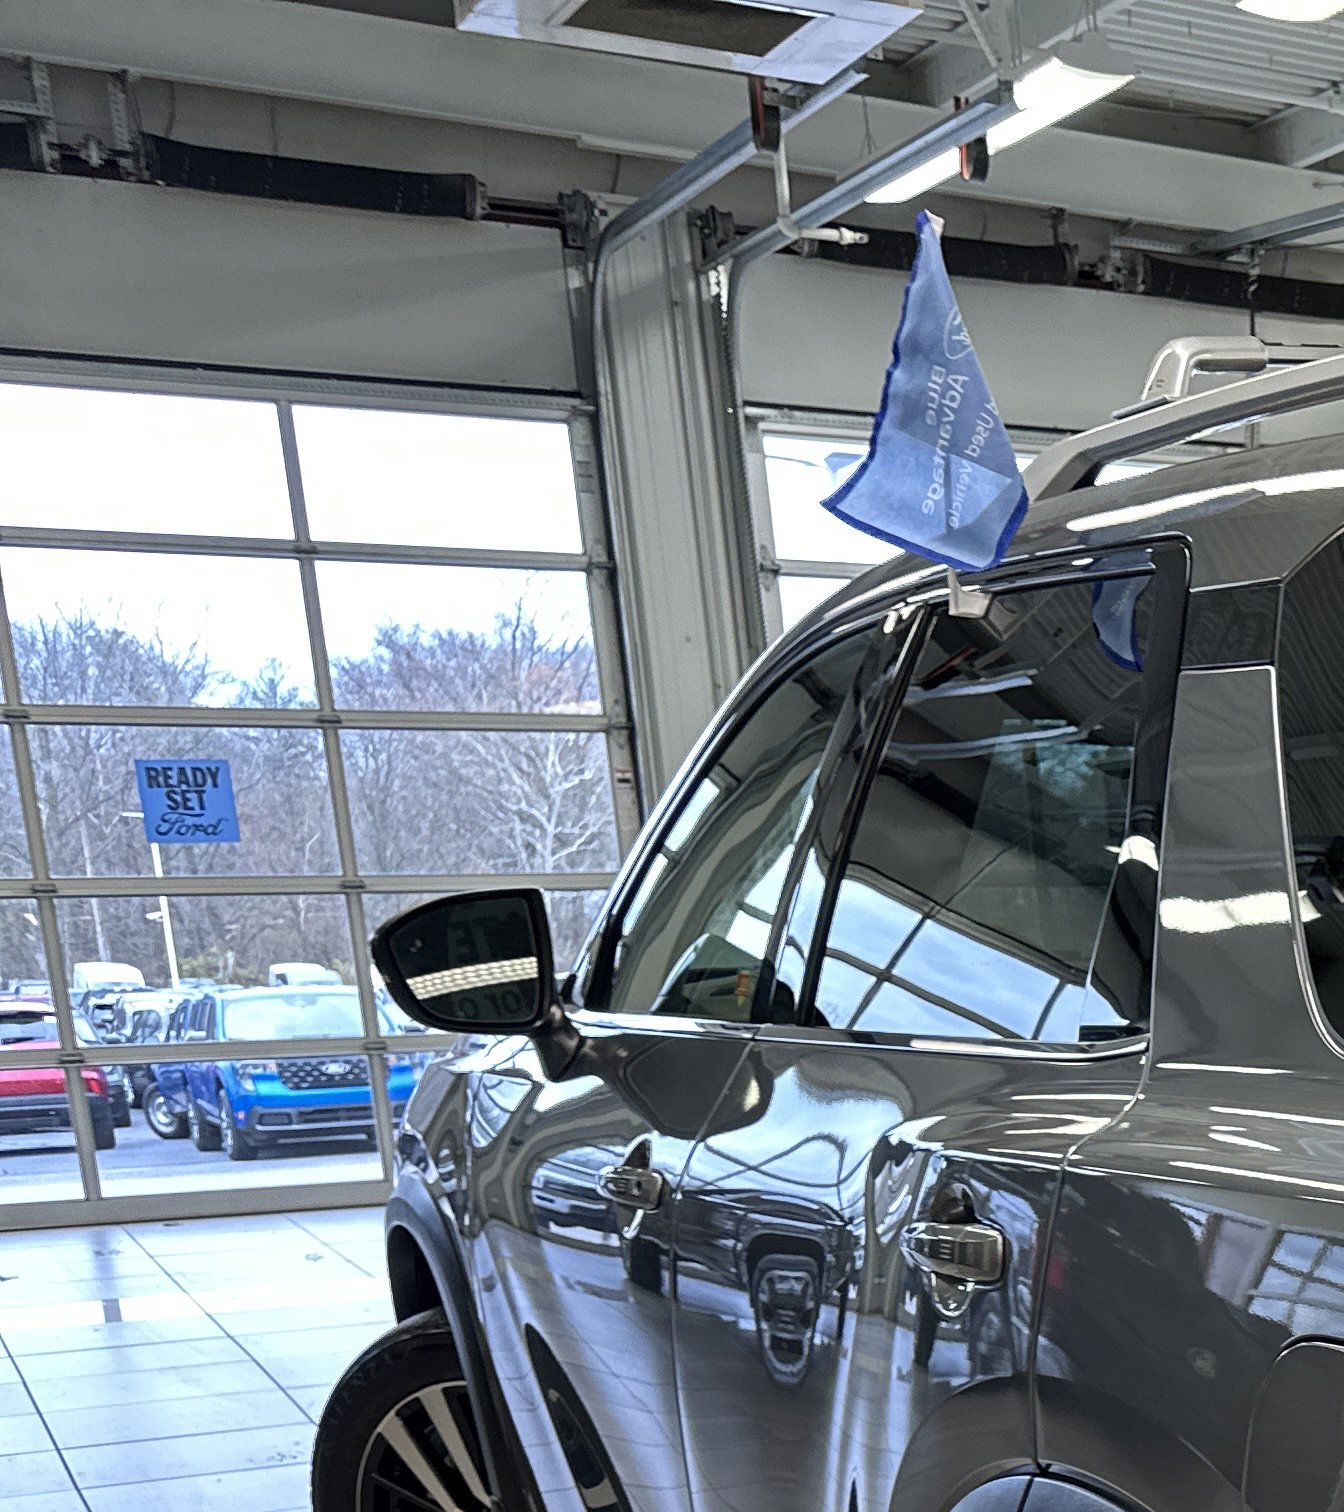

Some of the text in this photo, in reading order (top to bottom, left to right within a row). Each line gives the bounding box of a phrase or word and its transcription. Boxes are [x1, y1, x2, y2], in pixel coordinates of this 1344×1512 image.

[143, 765, 220, 789] READY
[164, 788, 207, 811] SET
[154, 811, 225, 837] Ford
